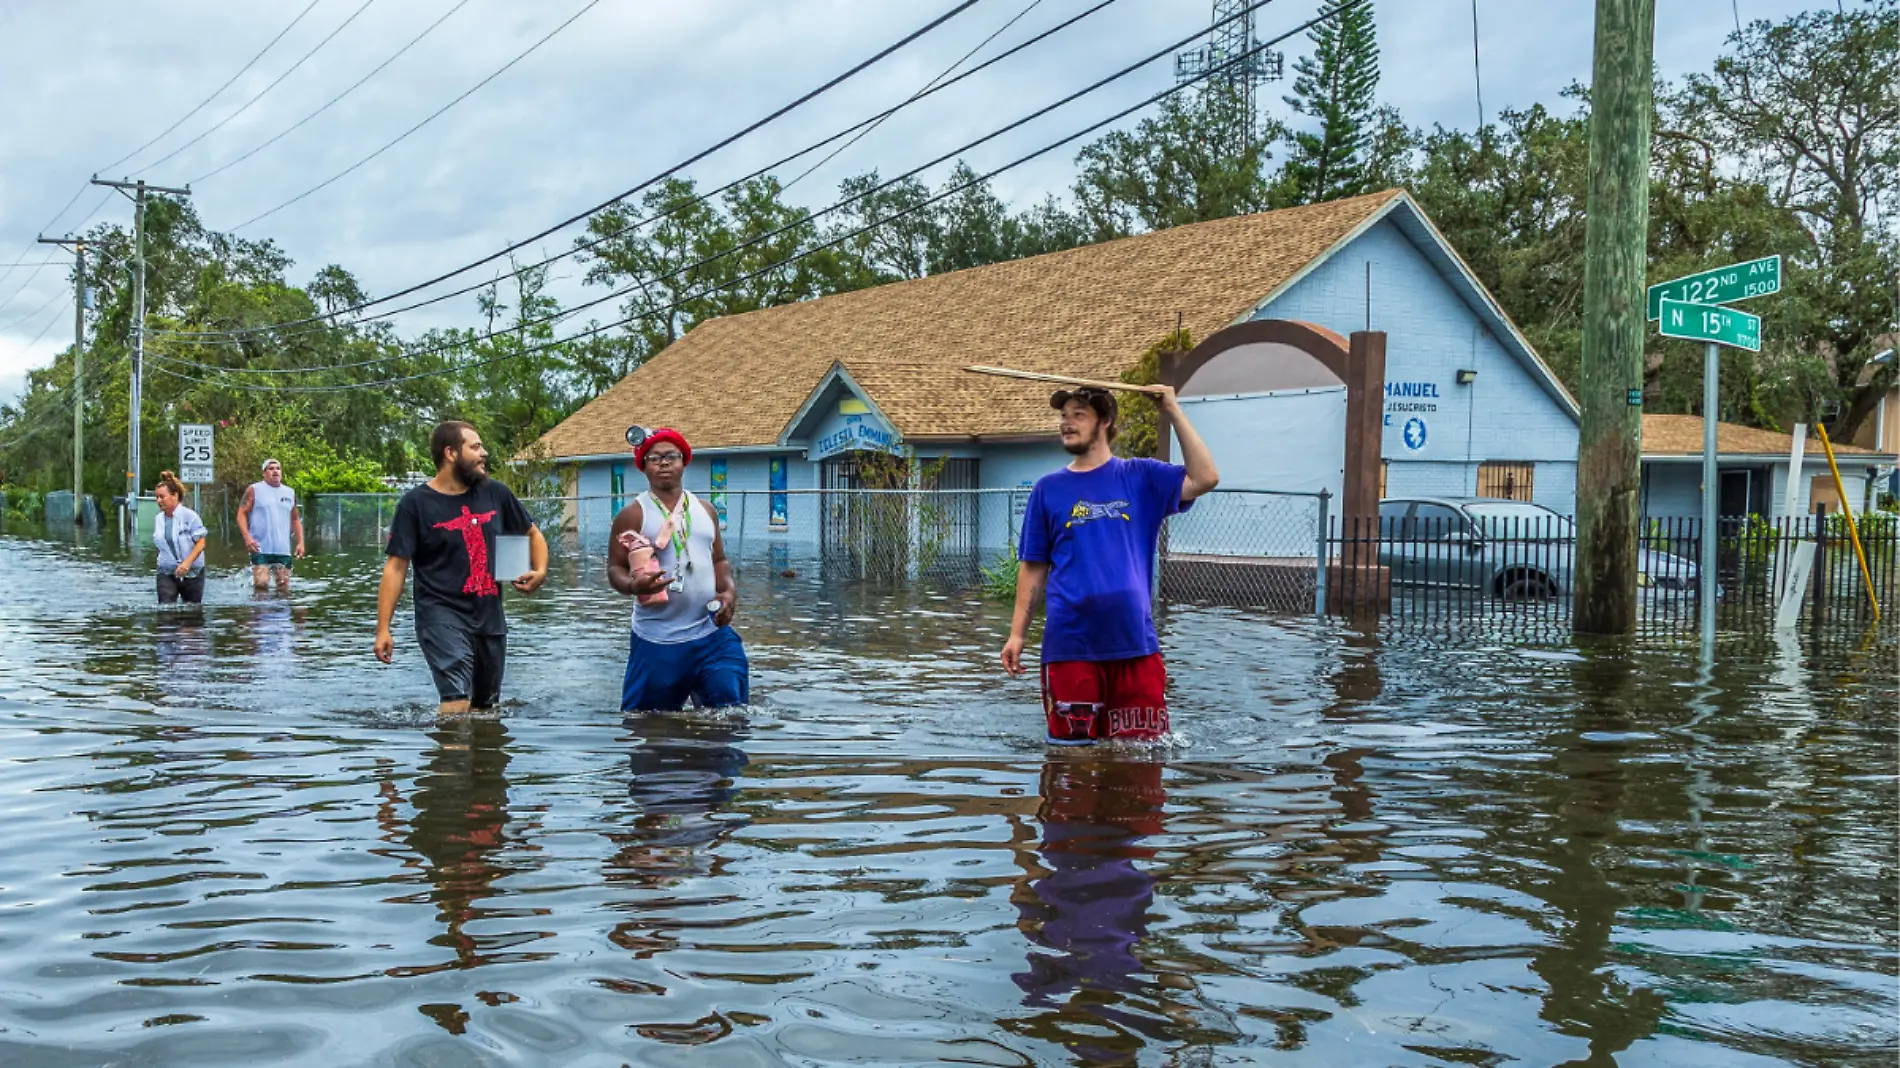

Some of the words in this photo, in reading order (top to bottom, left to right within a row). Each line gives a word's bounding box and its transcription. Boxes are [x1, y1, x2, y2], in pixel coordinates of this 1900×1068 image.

[1682, 273, 1737, 302] 122ND
[1750, 260, 1774, 275] AVE
[1745, 280, 1775, 297] 1500
[1672, 309, 1684, 327] N
[1702, 311, 1732, 335] 15TH
[1388, 403, 1436, 412] JESUCRISTO
[183, 428, 210, 436] SPEED
[184, 446, 210, 461] 25
[1109, 707, 1167, 736] BULLS
